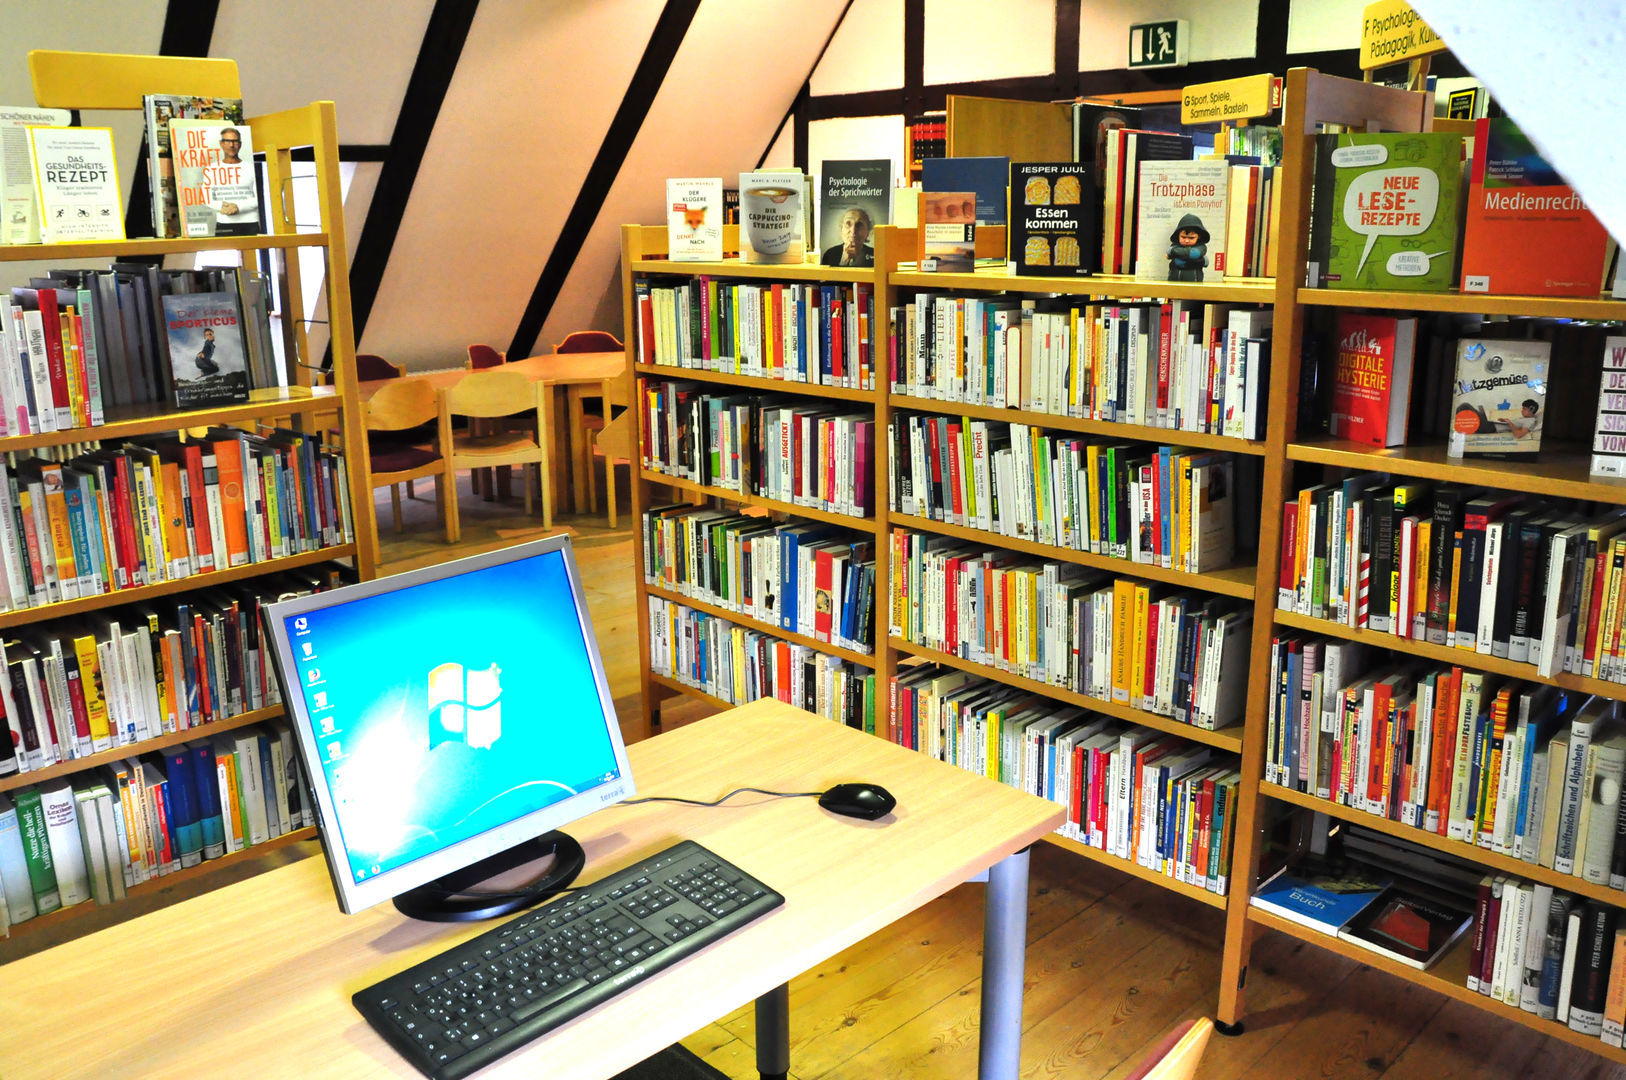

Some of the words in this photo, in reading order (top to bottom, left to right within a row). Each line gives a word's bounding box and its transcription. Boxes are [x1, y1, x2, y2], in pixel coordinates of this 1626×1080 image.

[1184, 95, 1190, 106] G
[1224, 103, 1248, 115] Basteln
[187, 130, 208, 149] DIE
[179, 149, 221, 168] KRAFT
[47, 171, 108, 182] REZEPT
[202, 167, 241, 186] STOFF
[1021, 166, 1058, 174] JESPER
[1061, 166, 1085, 174] JUUL
[829, 176, 868, 187] Psychologie
[1383, 176, 1420, 190] NEUE
[184, 182, 211, 206] DIÄT
[828, 188, 840, 197] der
[841, 187, 883, 198] Sprichwörter
[1150, 182, 1215, 200] Trotzphase
[1197, 200, 1223, 210] Ponyhof
[1358, 191, 1416, 211] LESE-
[1036, 207, 1068, 218] Essen
[1361, 211, 1421, 226] REZEPTE
[752, 221, 789, 229] STRATEGIE
[1025, 217, 1078, 229] kommen
[169, 317, 237, 330] SPORTICUS
[937, 305, 945, 341] LIEBE
[1159, 332, 1169, 383] MENSCHENKINDER
[1338, 352, 1385, 373] DIGITALE
[1612, 347, 1626, 368] W
[1338, 370, 1388, 391] HYSTERIE
[975, 431, 983, 459] Precht
[1143, 488, 1151, 501] USA
[1570, 744, 1584, 784] Alphabete
[600, 790, 619, 802] terra
[1119, 777, 1127, 800] Eltern
[1568, 787, 1578, 802] und
[35, 806, 47, 840] Pflanzen
[1560, 804, 1577, 859] Schriftzeichen
[26, 830, 35, 839] die
[30, 839, 40, 860] Nutze
[1288, 892, 1326, 910] Buch
[1592, 912, 1606, 952] SCHOLL-LATOUR
[1591, 952, 1599, 968] PETER
